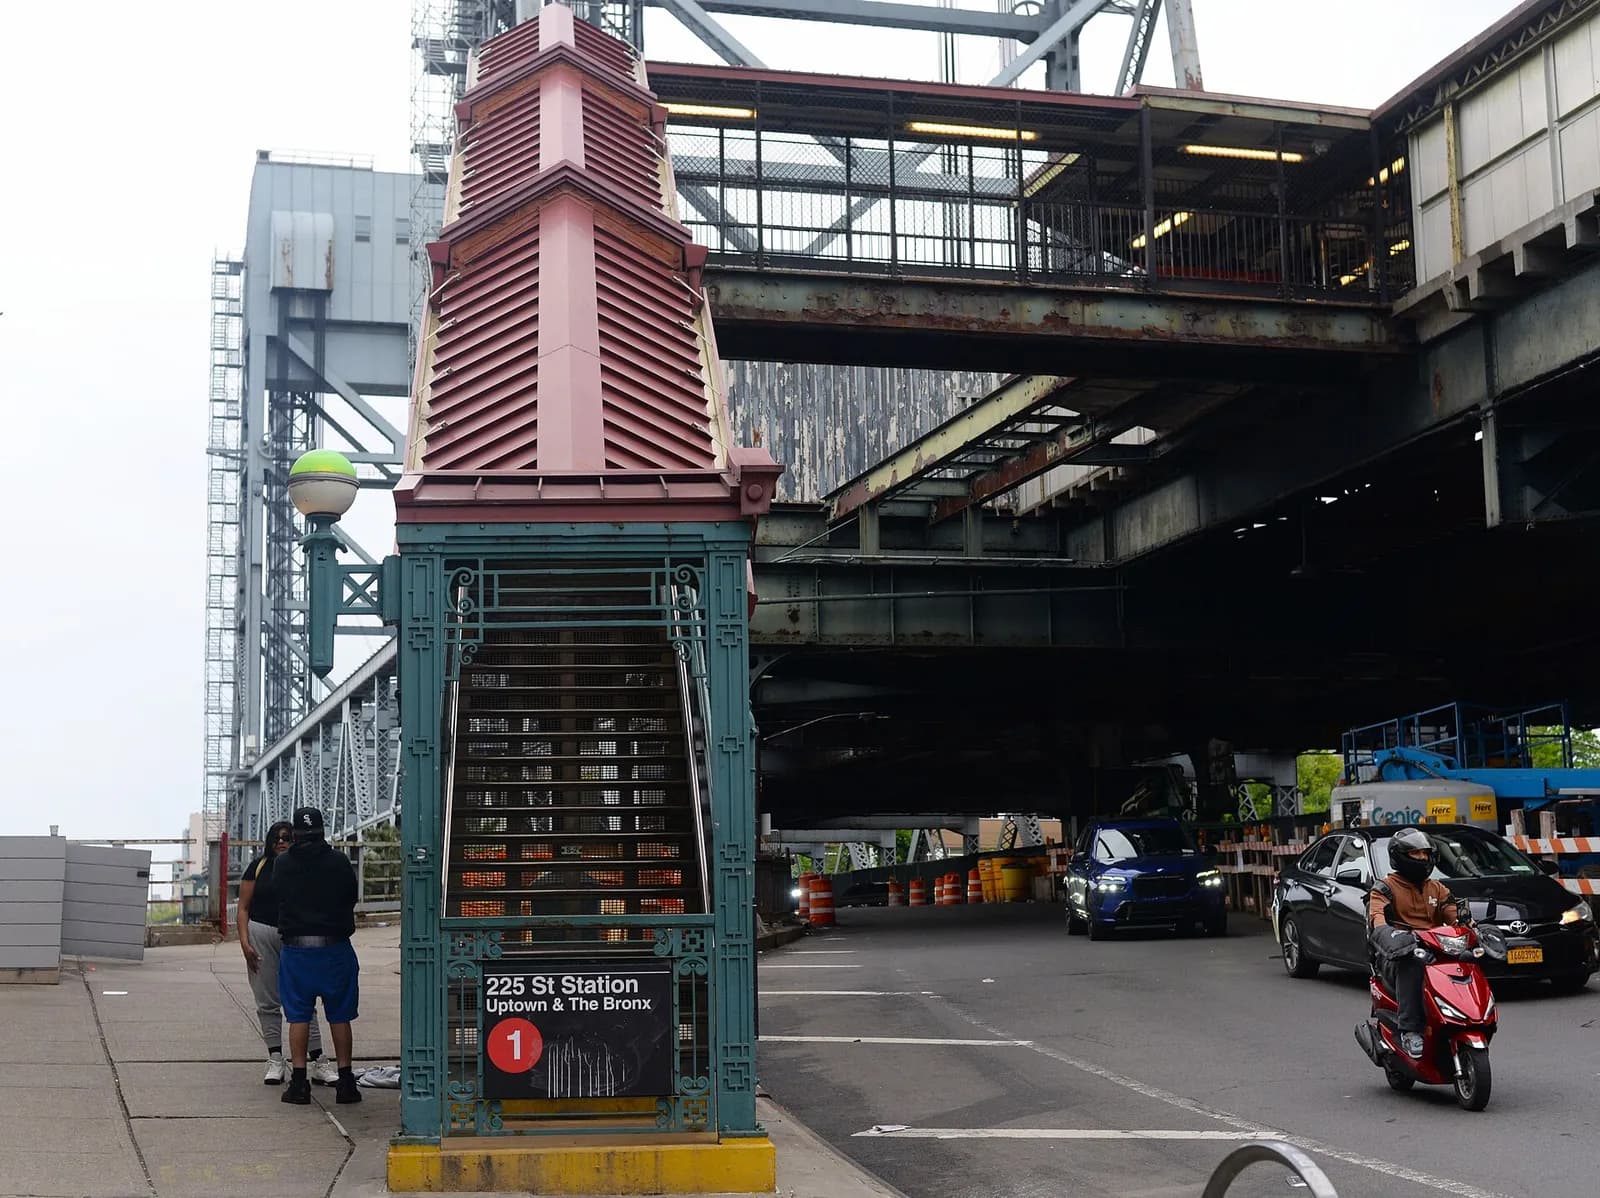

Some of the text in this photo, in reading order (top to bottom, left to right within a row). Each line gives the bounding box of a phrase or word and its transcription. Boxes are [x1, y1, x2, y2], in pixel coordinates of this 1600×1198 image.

[1431, 807, 1451, 815] Herc
[1474, 804, 1492, 812] Herc
[486, 975, 639, 996] 225 St Station
[486, 996, 652, 1015] Uptown & The Bronx
[506, 1030, 521, 1060] 1
